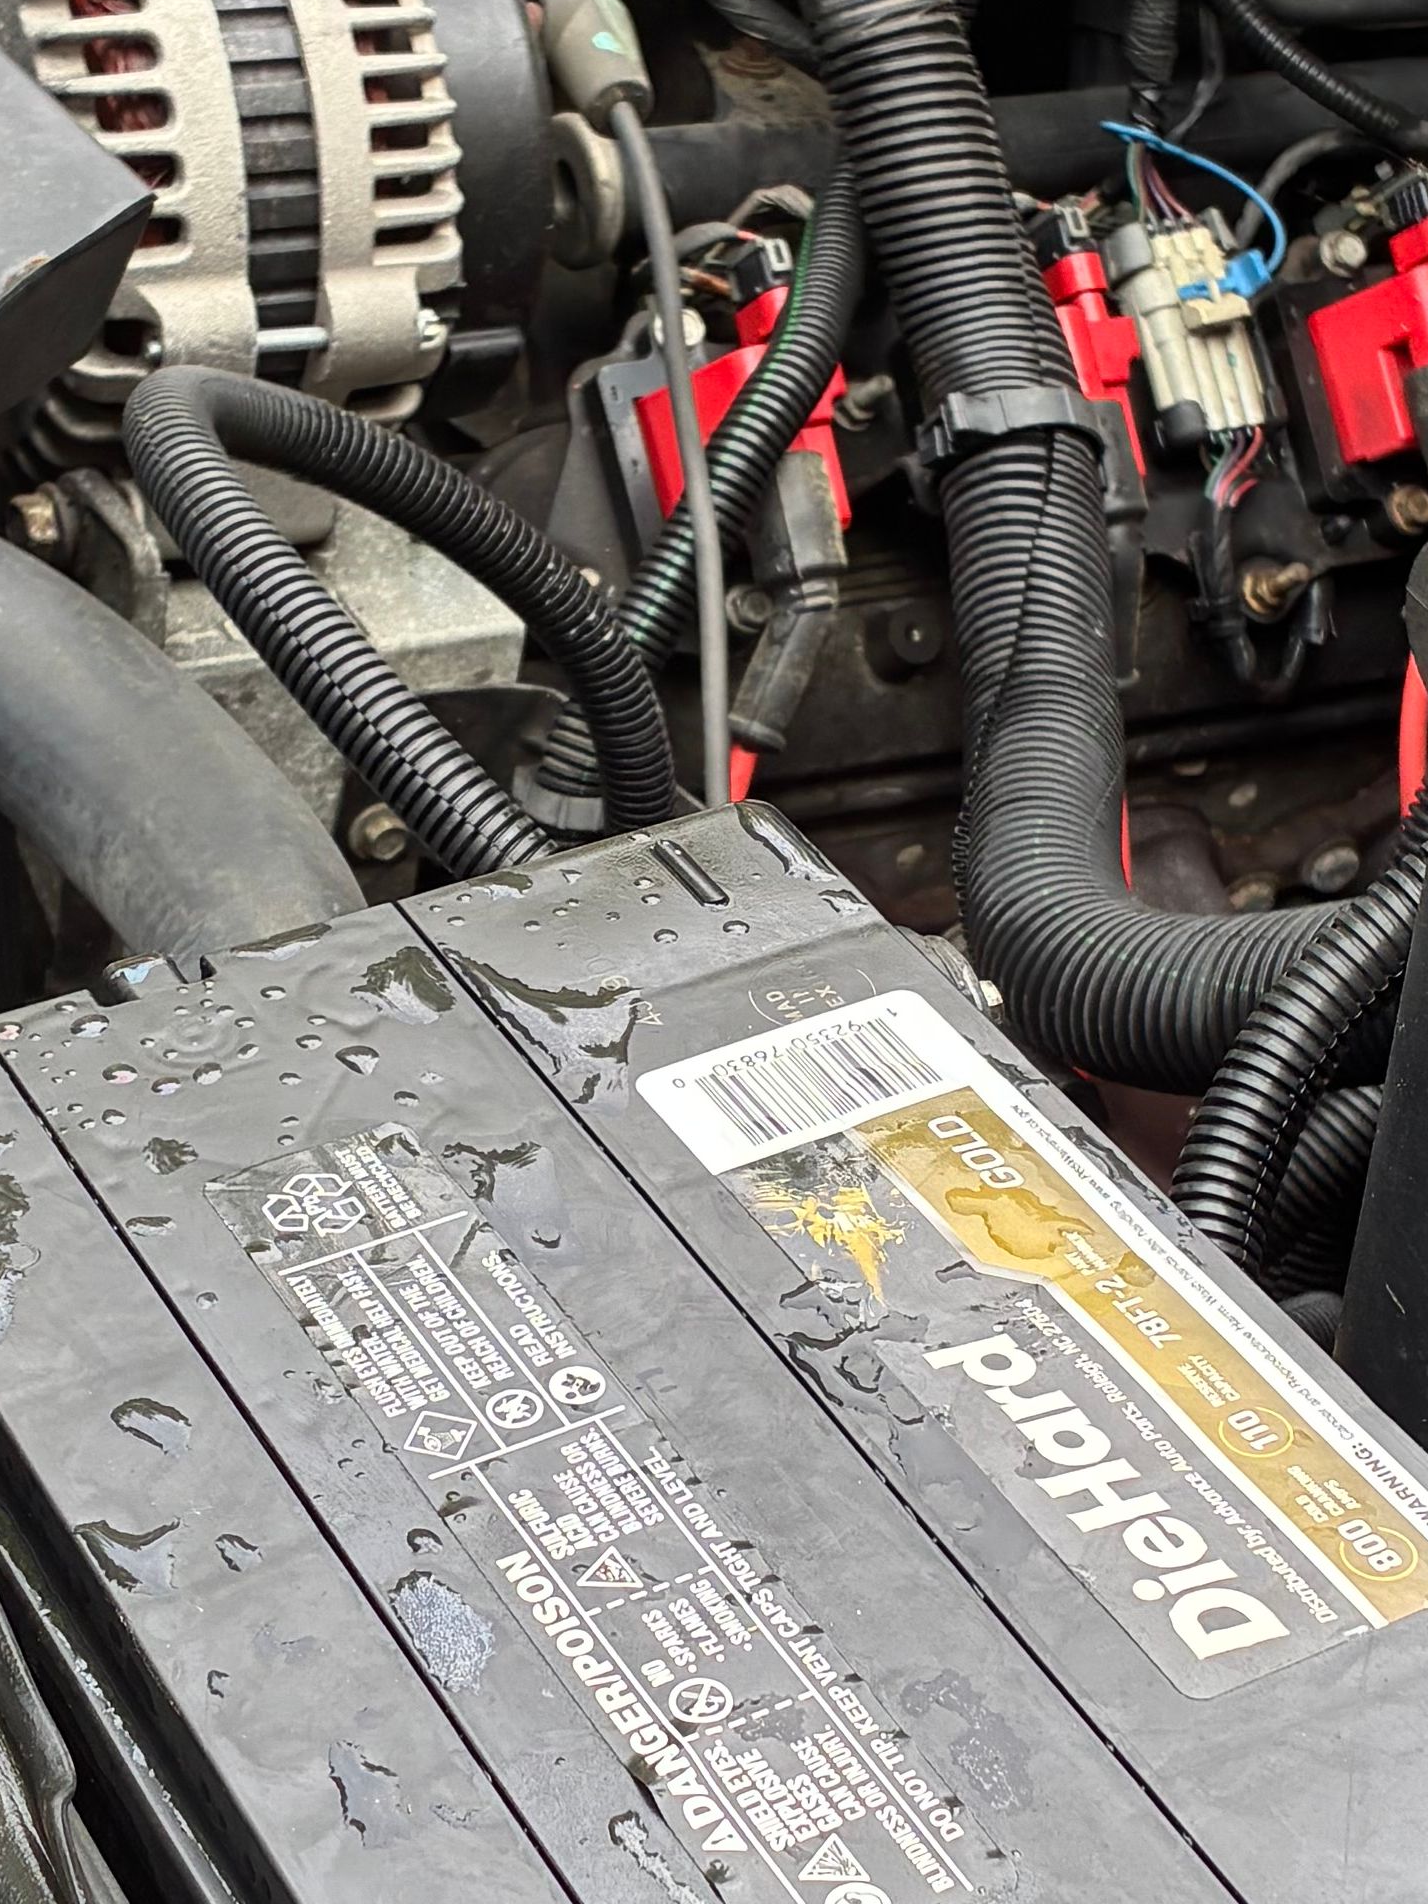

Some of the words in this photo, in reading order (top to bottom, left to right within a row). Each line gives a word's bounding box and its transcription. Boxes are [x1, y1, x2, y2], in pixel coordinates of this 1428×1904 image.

[785, 1016, 864, 1053] 92350
[884, 1005, 899, 1018] 1
[668, 1075, 688, 1091] 0
[707, 1043, 783, 1079] 76830
[333, 1147, 369, 1180] MUST
[927, 1114, 1025, 1189] GOLD
[301, 1192, 329, 1216] Pb
[356, 1178, 407, 1230] BATTERY
[398, 1199, 422, 1219] BE
[335, 1265, 373, 1299] FAST.
[397, 1282, 431, 1312] THE
[404, 1253, 467, 1320] CHILDREN.
[481, 1249, 577, 1359] INSTRUCTIONS.
[285, 1274, 356, 1350] IMMEDIATELY
[357, 1298, 394, 1329] HELP
[416, 1306, 445, 1328] OF
[451, 1319, 481, 1338] OF
[1094, 1273, 1183, 1349] 78FT-2
[340, 1346, 379, 1379] EYES
[360, 1331, 404, 1379] WATER.
[381, 1324, 433, 1379] MEDICAL
[430, 1327, 466, 1355] OUT
[466, 1335, 515, 1381] REACH
[508, 1323, 554, 1367] READ
[1051, 1335, 1081, 1355] NC
[390, 1374, 428, 1411] WITH
[417, 1376, 451, 1402] GET
[452, 1355, 492, 1389] KEEP
[1175, 1362, 1226, 1408] RESERVE
[1187, 1354, 1241, 1401] CAPACITY
[362, 1375, 407, 1418] FLUSH
[560, 1441, 588, 1464] OR
[579, 1426, 627, 1477] BURNS.
[1227, 1409, 1279, 1450] 110
[642, 1444, 694, 1504] LEVEL.
[1153, 1439, 1193, 1471] Auto
[552, 1468, 598, 1515] CAUSE
[574, 1460, 643, 1535] BLINDNESS
[612, 1472, 665, 1526] SEVERE
[921, 1332, 1290, 1660] DieHard
[1183, 1471, 1246, 1525] Advance
[507, 1488, 575, 1560] SULFURIC
[555, 1512, 598, 1550] ACID
[584, 1510, 620, 1543] CAN
[681, 1502, 723, 1538] AND
[708, 1540, 761, 1593] TIGHT
[1336, 1518, 1403, 1572] 800
[1252, 1545, 1338, 1623] Distributed
[667, 1597, 724, 1656] FLAMES
[688, 1578, 751, 1645] SMOKING
[751, 1587, 800, 1638] CAPS
[640, 1608, 696, 1666] SPARKS
[640, 1658, 675, 1687] NO
[786, 1636, 837, 1687] VENT
[495, 1545, 725, 1830] DANGER/POISON
[827, 1685, 879, 1736] KEEP
[703, 1738, 752, 1794] EYES.
[789, 1735, 841, 1788] CAUSE
[812, 1723, 870, 1785] INJURY.
[869, 1732, 904, 1771] TIP.
[734, 1747, 820, 1842] EXPLOSIVE
[785, 1772, 843, 1832] GASES
[827, 1784, 866, 1821] CAN
[856, 1780, 887, 1808] OR
[892, 1768, 940, 1811] NOT
[735, 1788, 796, 1852] SHIELD
[928, 1807, 964, 1842] DO
[874, 1804, 955, 1893] BLINDNESS
